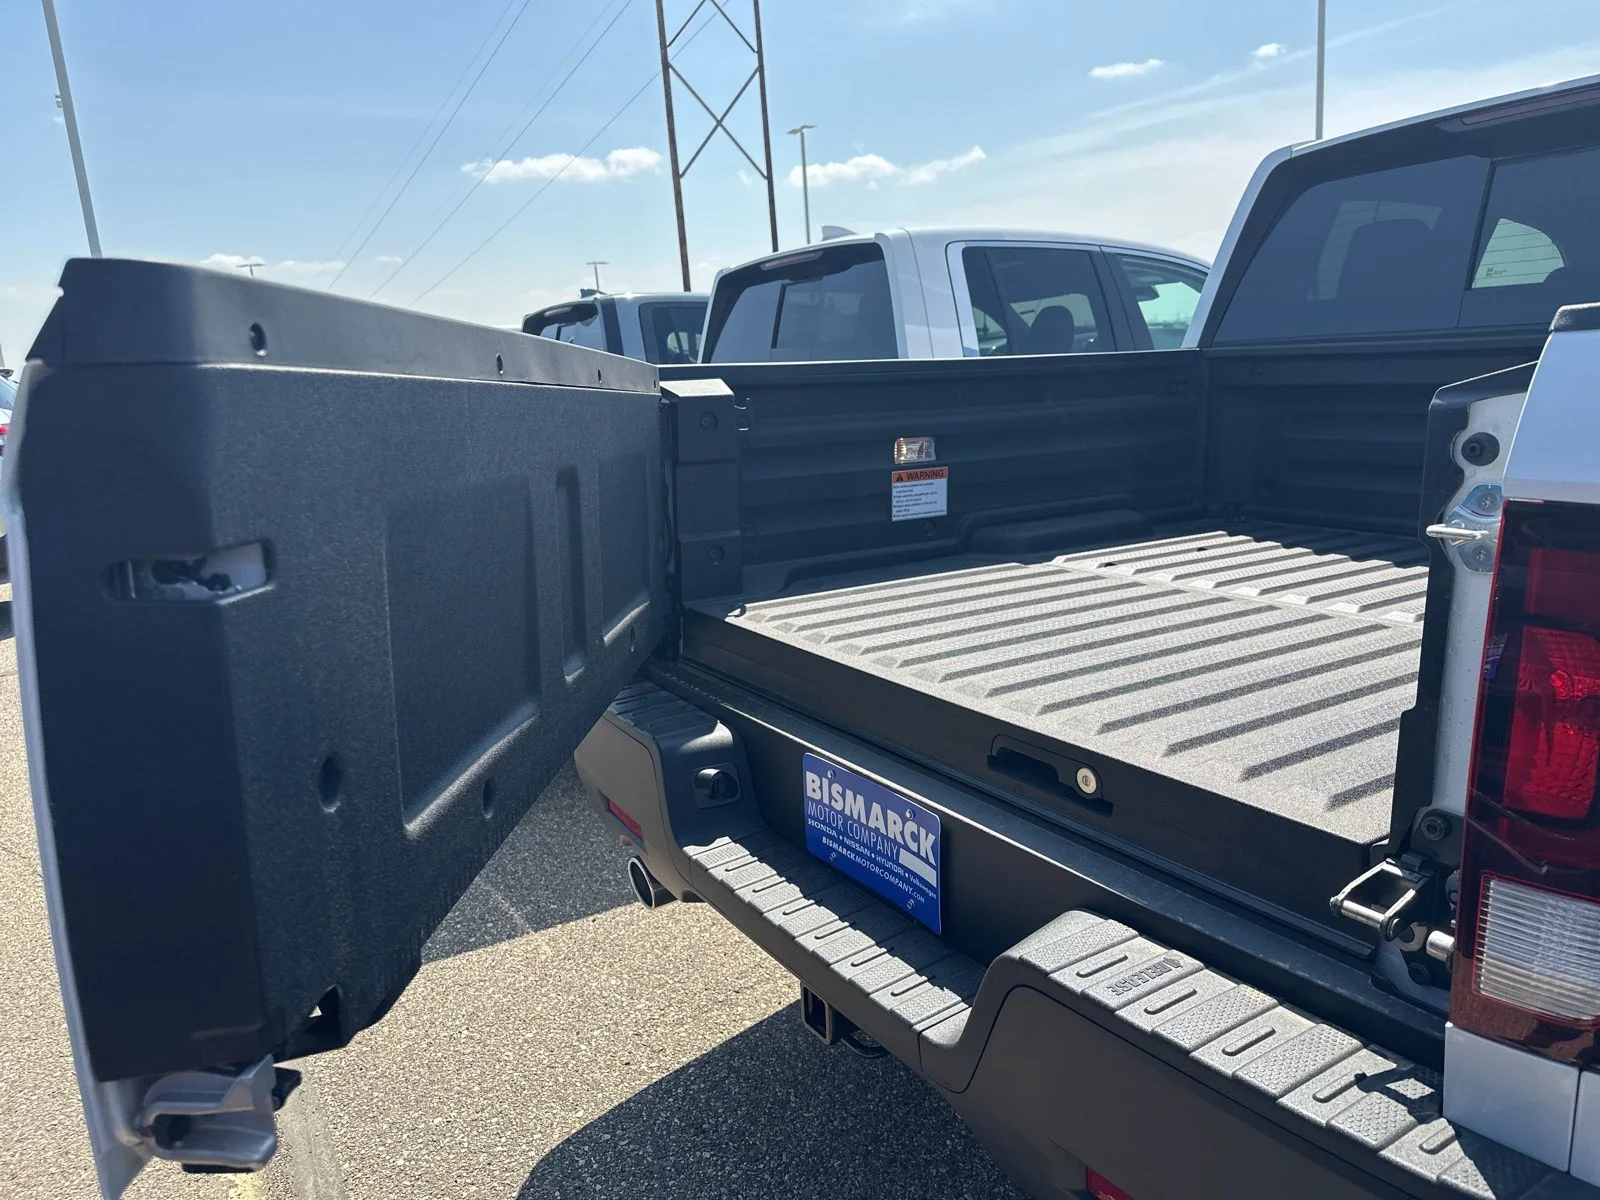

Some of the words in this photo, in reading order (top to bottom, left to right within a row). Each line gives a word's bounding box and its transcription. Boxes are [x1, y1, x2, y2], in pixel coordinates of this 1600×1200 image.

[906, 469, 944, 481] WARNING
[805, 770, 936, 866] BISMARCK
[807, 800, 844, 832] MOTOR
[847, 820, 898, 861] COMPANY
[807, 818, 838, 839] HONDA
[843, 836, 871, 858] NISSAN
[875, 855, 905, 877] HYUNDAI
[1106, 961, 1173, 996] RELEASE
